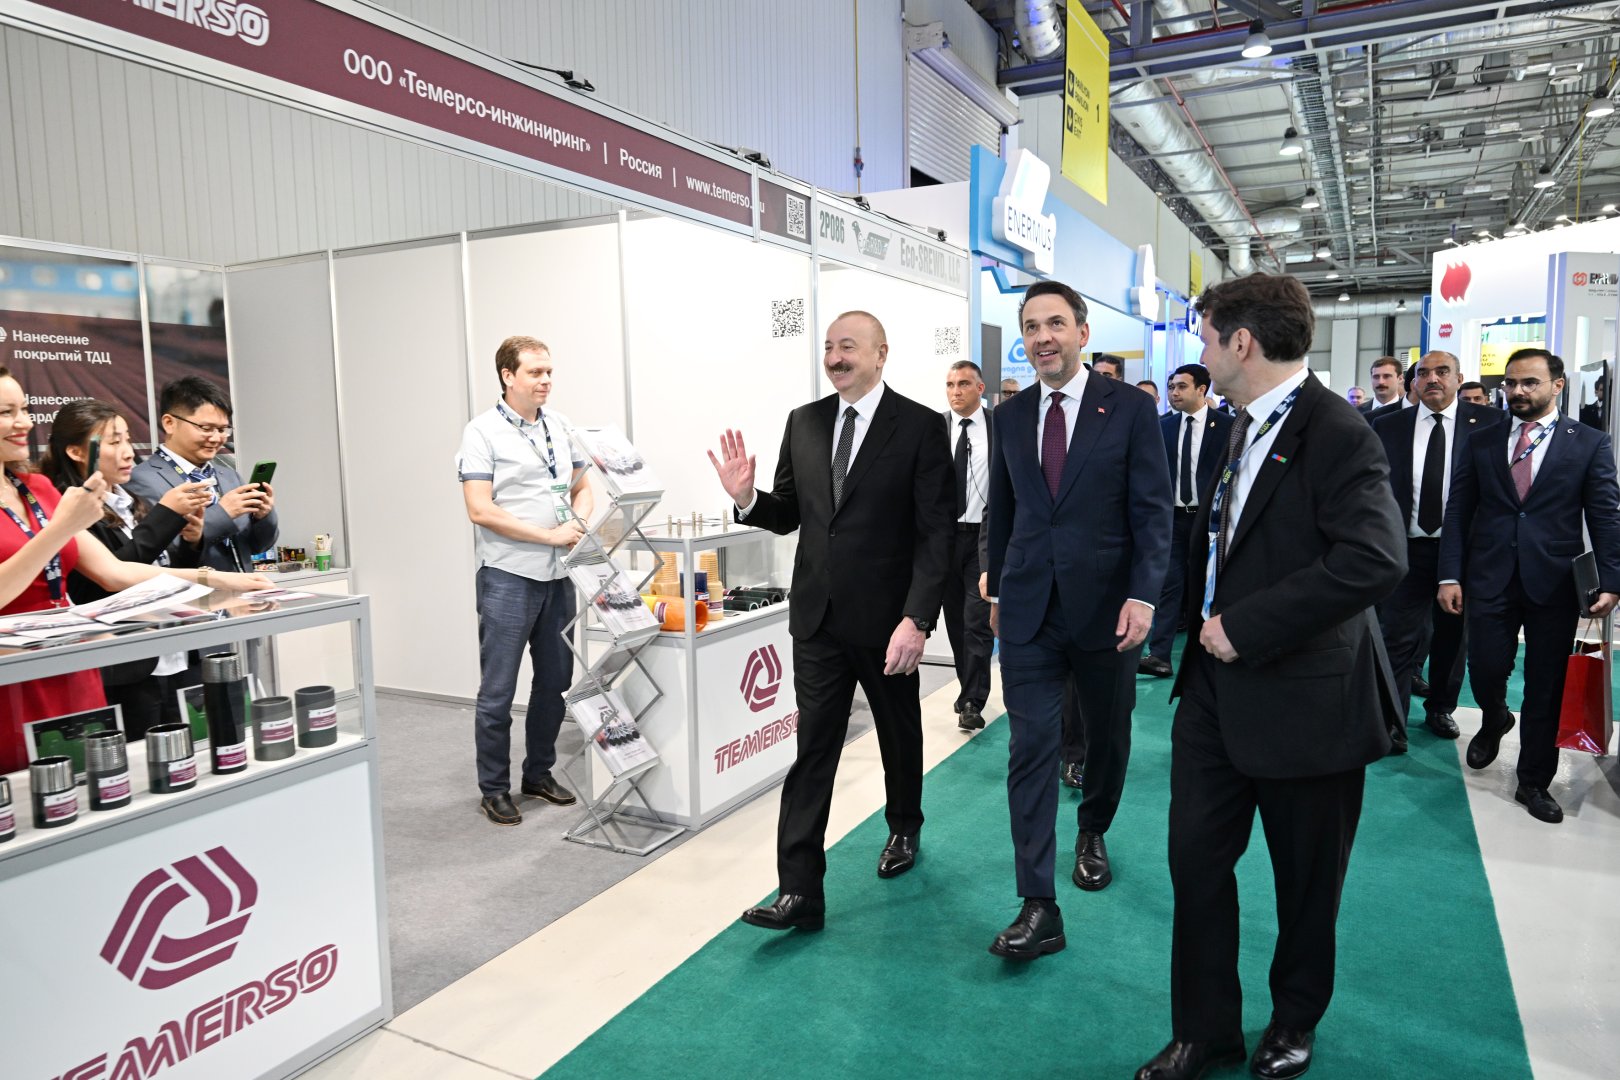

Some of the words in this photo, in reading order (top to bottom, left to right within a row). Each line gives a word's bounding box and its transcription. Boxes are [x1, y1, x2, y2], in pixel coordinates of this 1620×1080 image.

[343, 48, 393, 86] ООО
[398, 69, 591, 152] «Темерсо-инжиниринг»
[620, 148, 662, 179] Россия
[686, 175, 765, 214] www.temerso.u
[819, 210, 845, 244] 2P086
[12, 329, 90, 345] Нанесение
[14, 349, 82, 362] покрытий
[84, 351, 112, 364] ТДЦ
